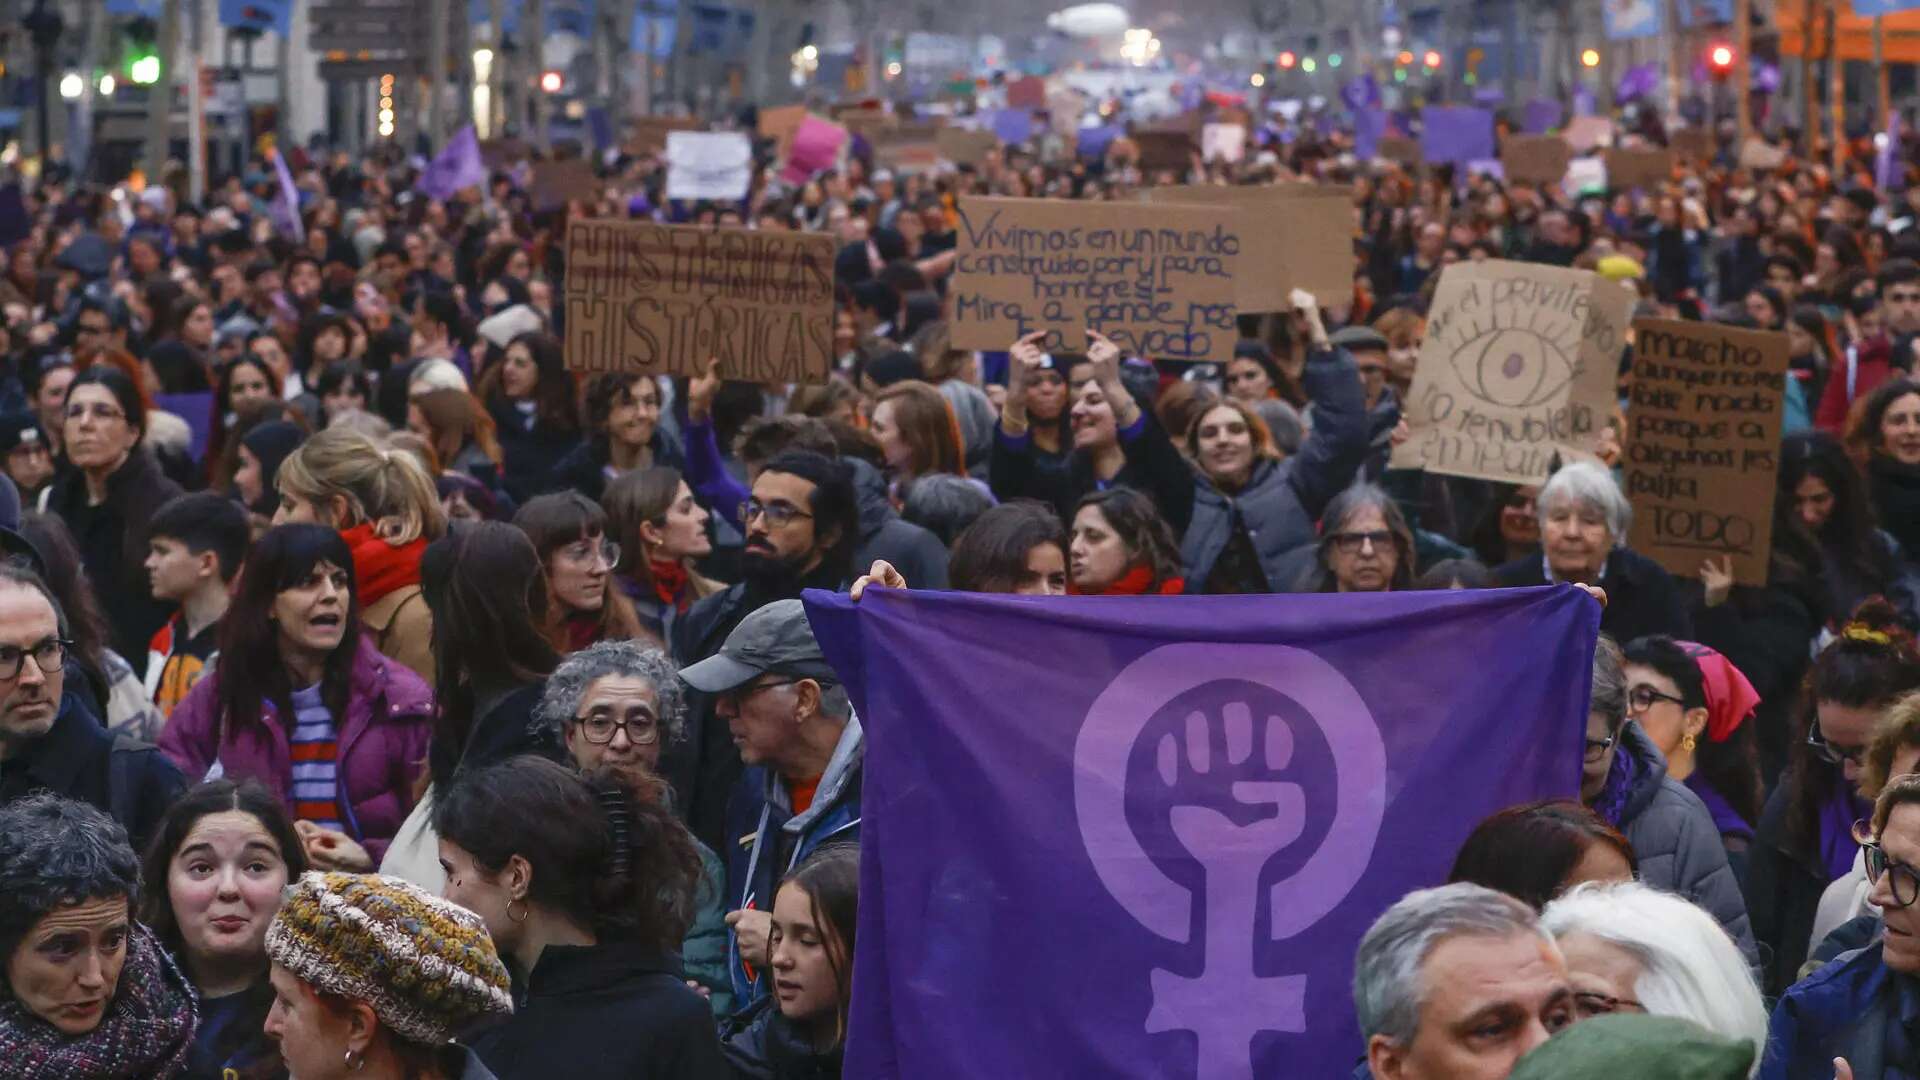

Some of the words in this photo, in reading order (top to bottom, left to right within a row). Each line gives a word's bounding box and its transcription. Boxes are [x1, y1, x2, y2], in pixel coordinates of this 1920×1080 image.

[955, 204, 1083, 251] Vivimos
[1157, 224, 1240, 255] mundo
[957, 252, 1090, 276] construido
[1156, 255, 1232, 293] para
[957, 293, 1033, 322] Mira
[1042, 301, 1074, 322] a
[1188, 300, 1238, 331] nos
[1651, 505, 1754, 547] TODO
